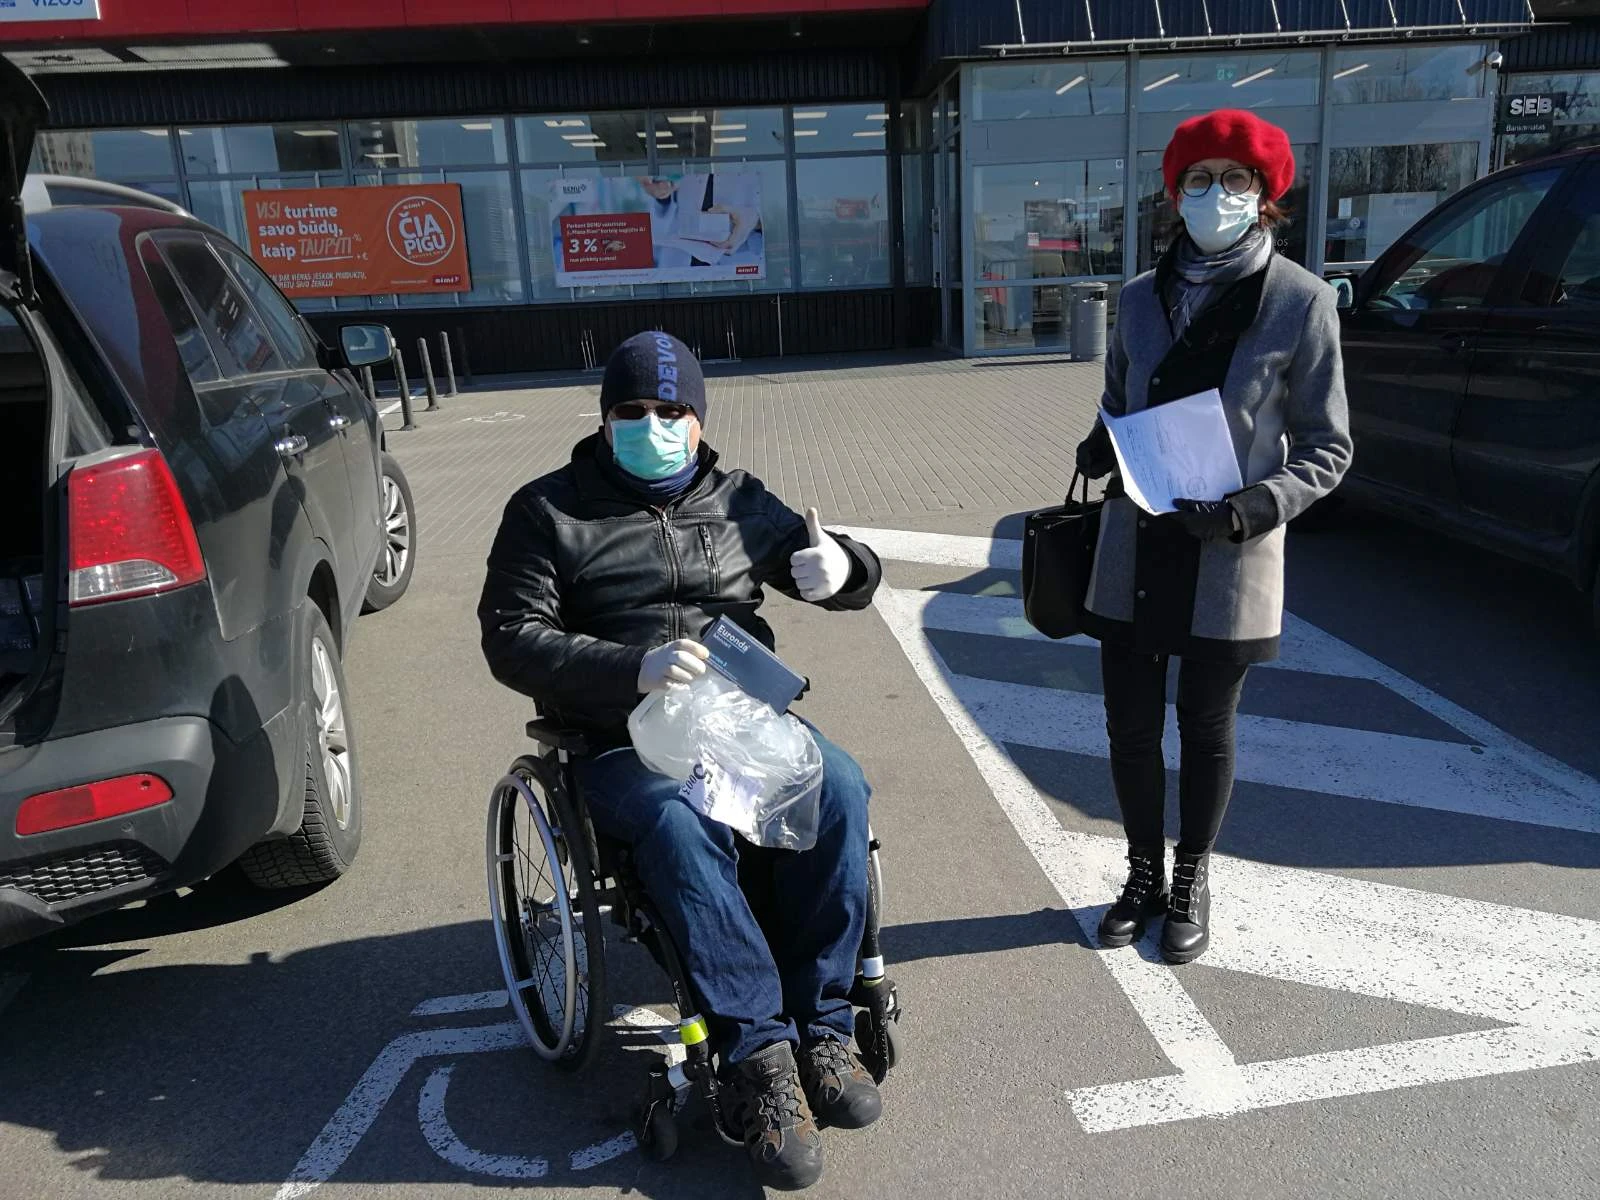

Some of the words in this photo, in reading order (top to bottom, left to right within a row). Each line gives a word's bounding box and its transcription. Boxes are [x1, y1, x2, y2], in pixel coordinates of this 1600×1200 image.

[1510, 97, 1552, 115] SEB
[256, 201, 280, 218] VISI
[284, 204, 338, 218] turime
[259, 224, 295, 236] savo
[298, 220, 343, 237] būdų,
[398, 211, 442, 239] ČIA
[261, 242, 296, 260] kaip
[298, 236, 352, 256] TAUPYTI
[403, 234, 446, 255] PIGU
[569, 238, 580, 254] 3
[584, 238, 597, 252] %
[718, 624, 749, 652] Euronda
